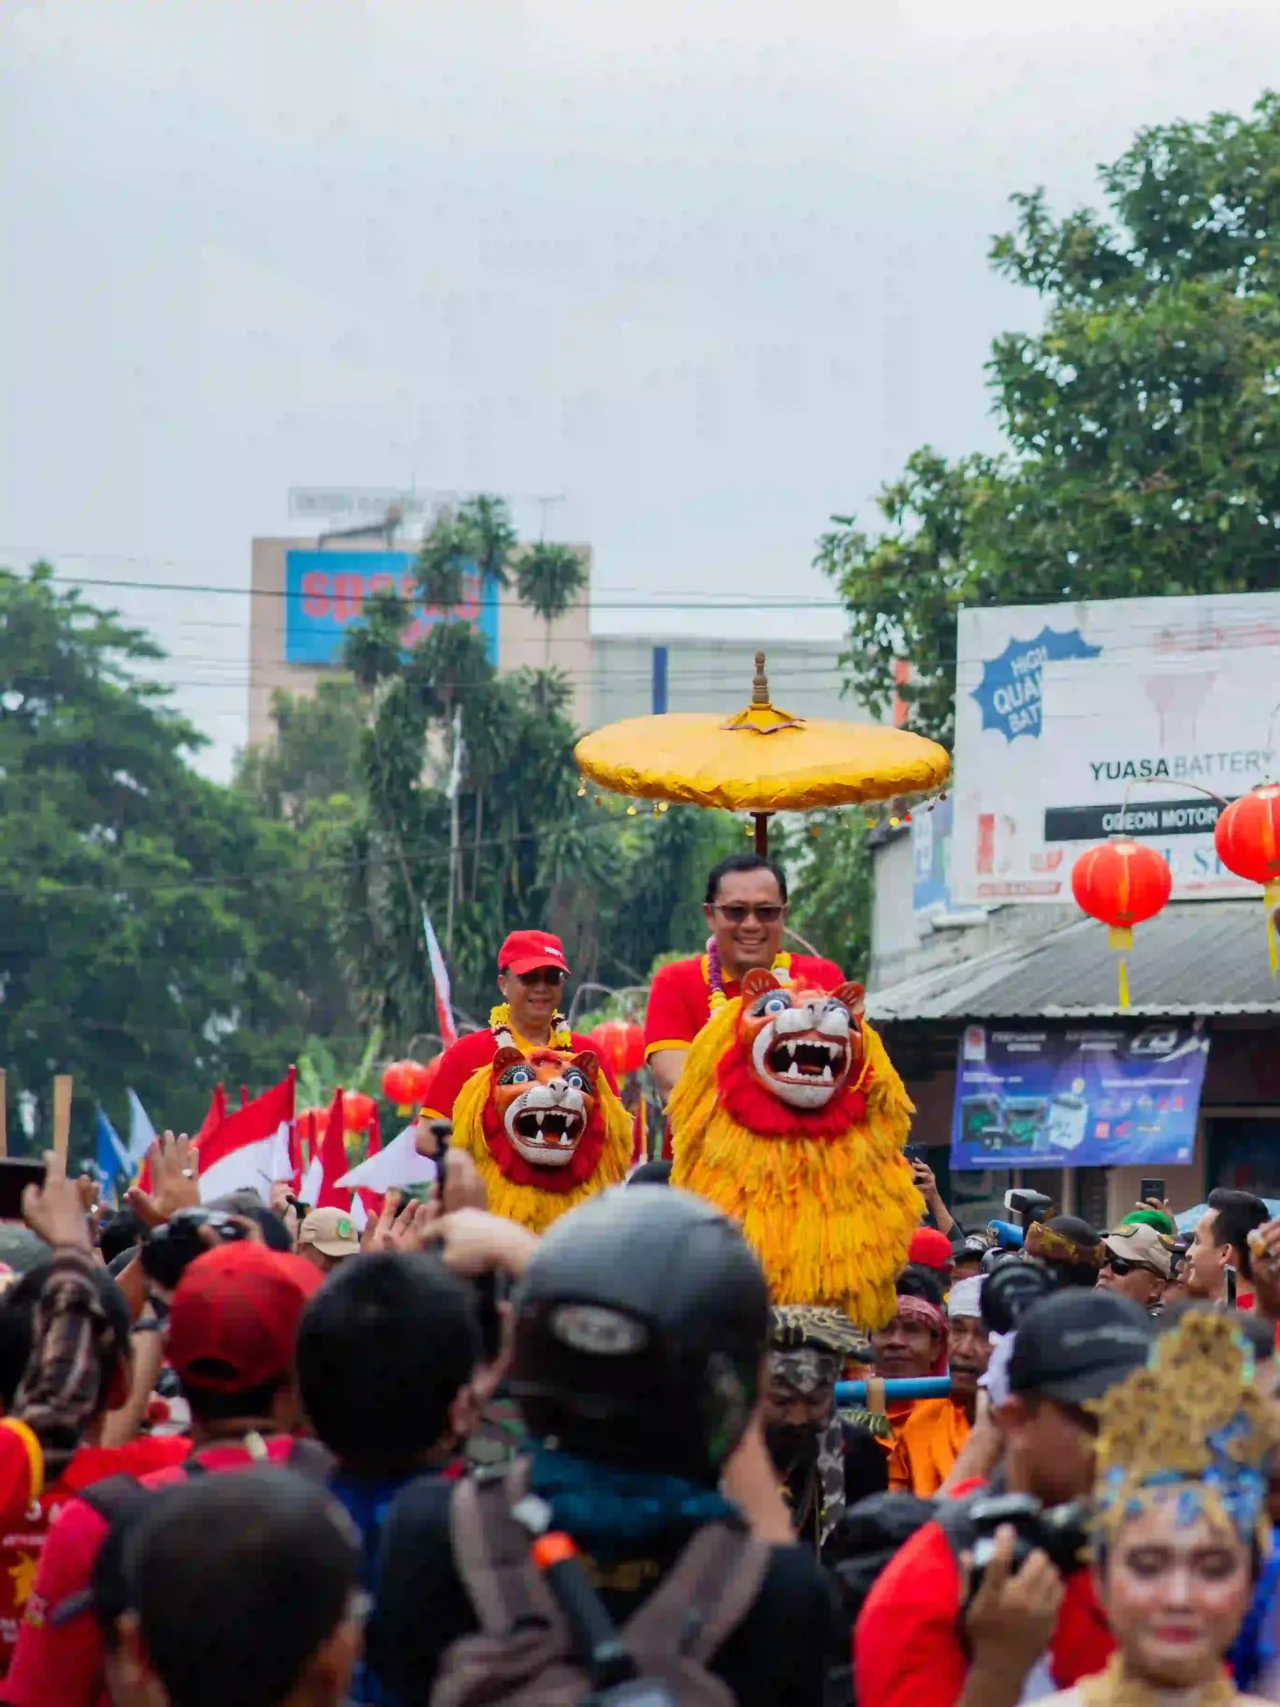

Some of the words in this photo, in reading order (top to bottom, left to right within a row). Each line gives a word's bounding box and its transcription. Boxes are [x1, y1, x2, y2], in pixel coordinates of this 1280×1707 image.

[1090, 759, 1169, 781] YUASA
[1174, 750, 1276, 778] BATTERY
[1102, 812, 1158, 831] ODEON
[1161, 807, 1218, 829] MOTOR
